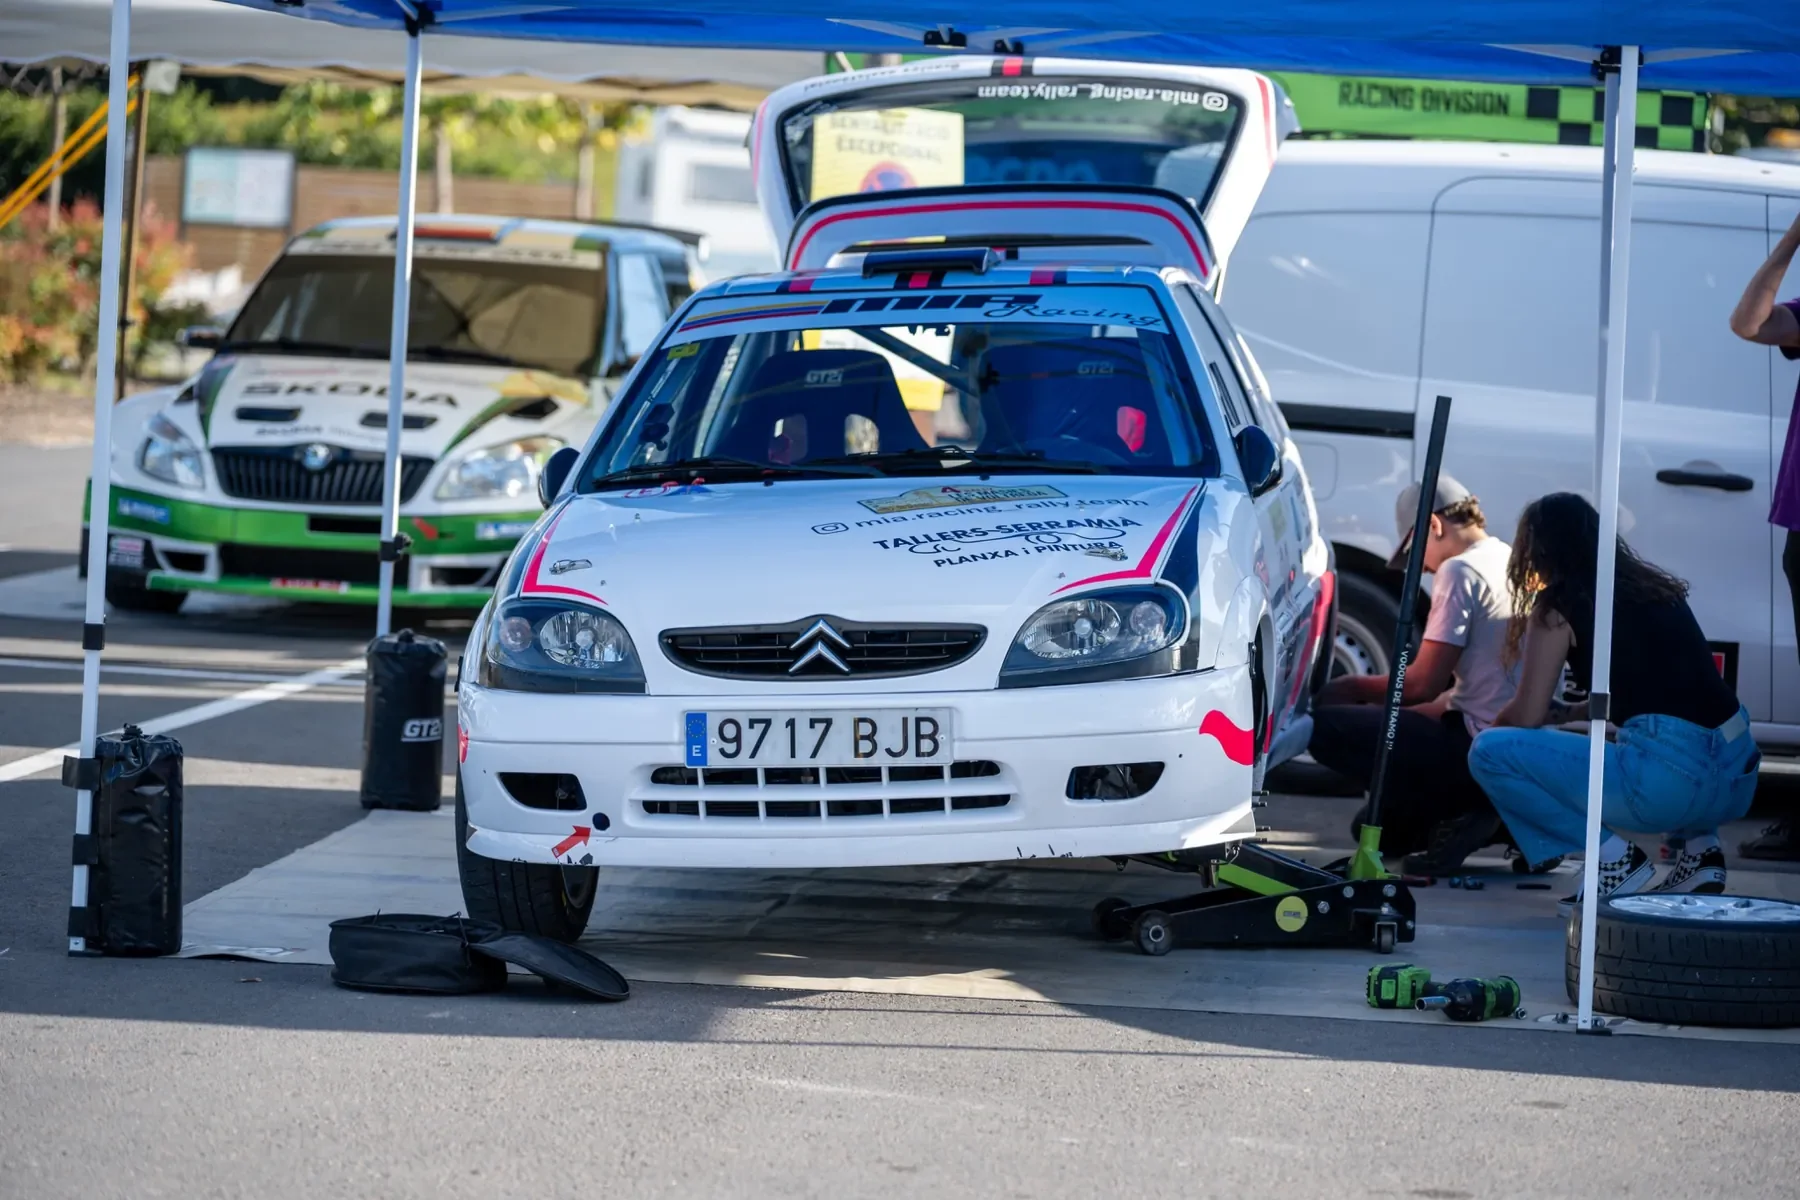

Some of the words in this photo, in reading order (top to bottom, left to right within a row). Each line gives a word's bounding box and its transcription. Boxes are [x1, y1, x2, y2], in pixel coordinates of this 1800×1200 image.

[978, 83, 1199, 105] mia.racing_rally.team
[1338, 81, 1415, 111] RACING
[1421, 87, 1511, 116] DIVISION
[983, 303, 1162, 326] Racing
[855, 498, 1149, 528] mia.racing_rally.team
[873, 527, 989, 549] TALLERS
[933, 548, 1019, 567] PLANXA
[1022, 547, 1031, 555] i
[1034, 541, 1123, 554] PINTURA
[1392, 691, 1402, 704] DE
[402, 719, 442, 738] GT2
[1386, 705, 1399, 739] TRAMO
[718, 717, 833, 760] 9717
[853, 716, 940, 759] BJB
[692, 745, 702, 757] E
